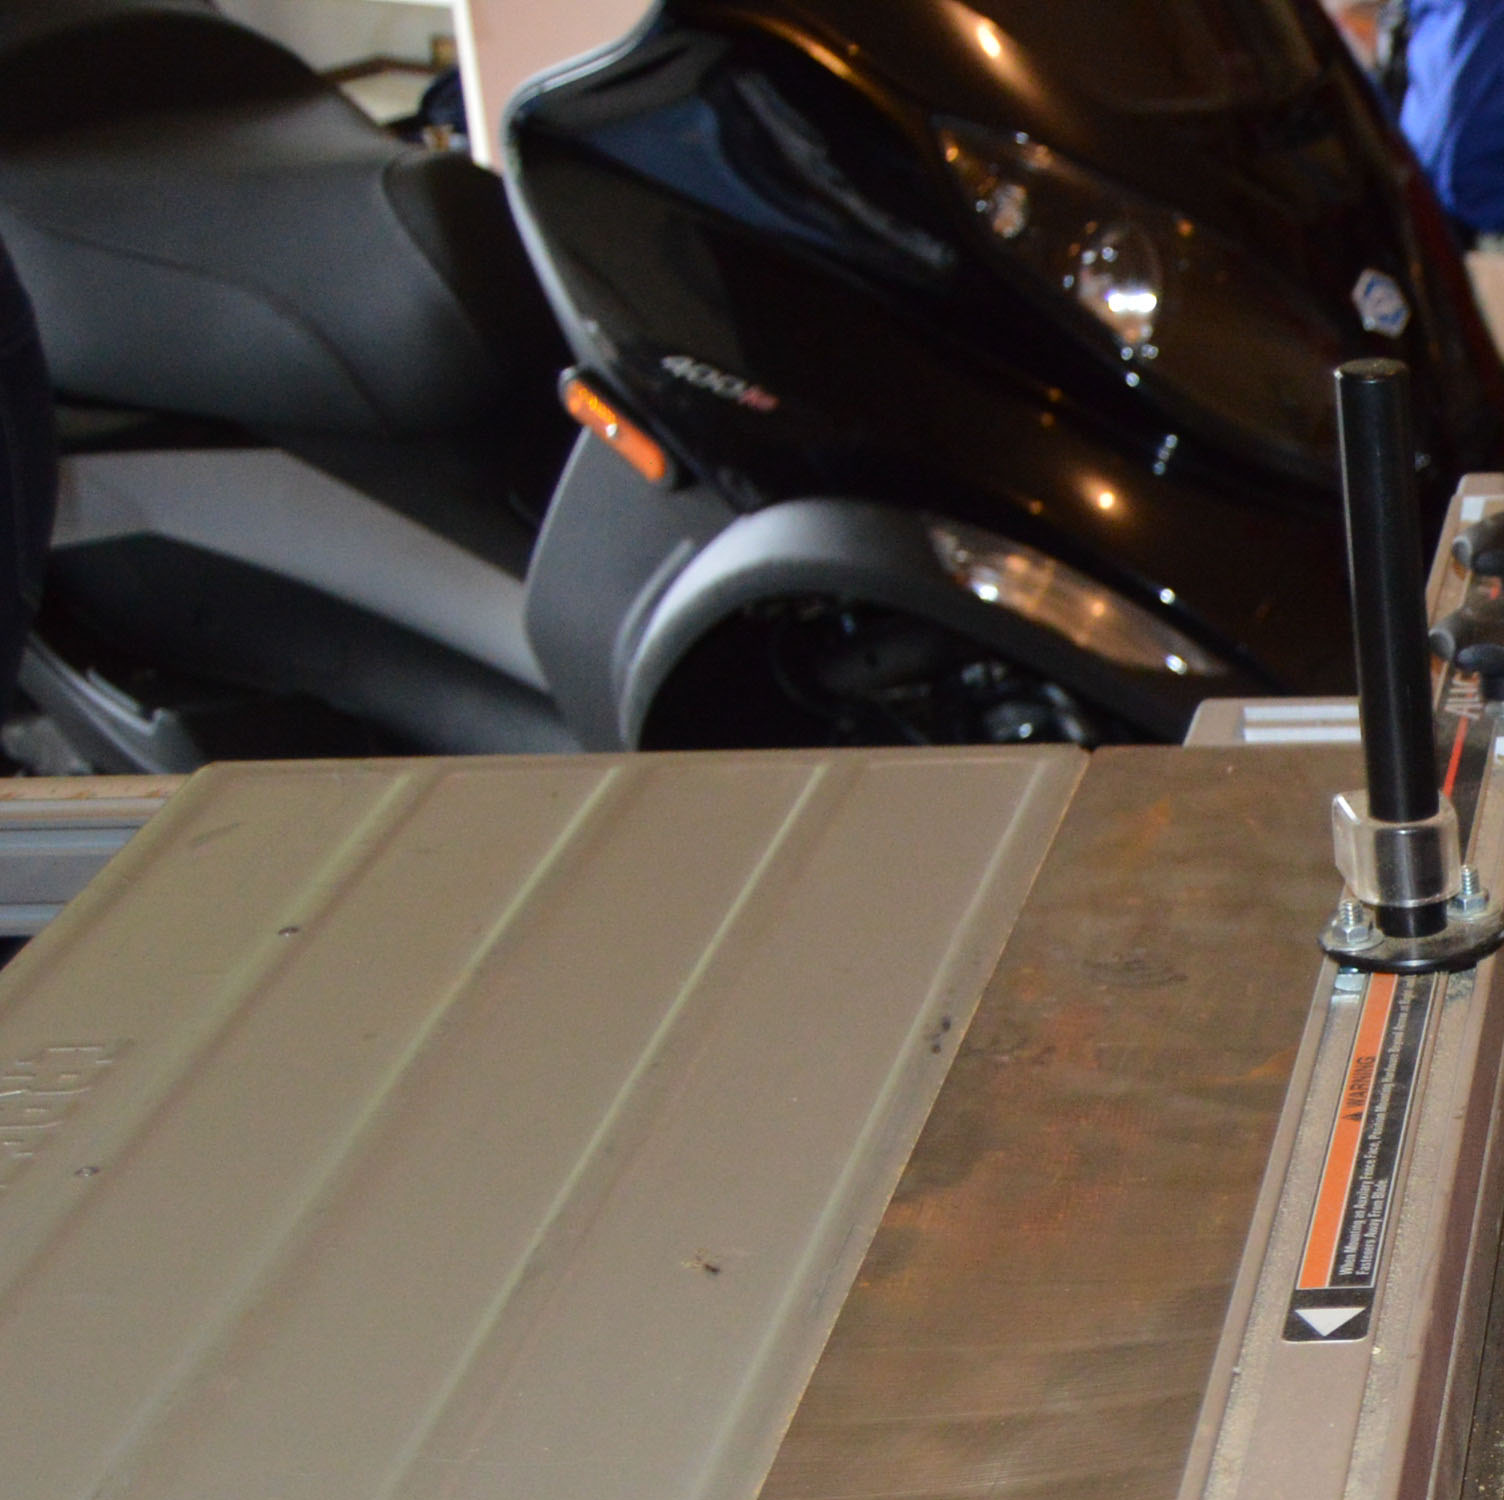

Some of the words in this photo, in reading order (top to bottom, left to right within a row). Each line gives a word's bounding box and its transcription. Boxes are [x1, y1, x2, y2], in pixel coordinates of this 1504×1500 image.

[1346, 1055, 1376, 1108] WARNING
[1363, 1140, 1383, 1158] Face,
[1359, 1159, 1377, 1179] Fence
[1367, 1200, 1385, 1217] From
[1343, 1219, 1366, 1252] Mounting
[1364, 1218, 1383, 1237] Away
[1338, 1254, 1356, 1275] When
[1355, 1238, 1377, 1274] Fasteners
